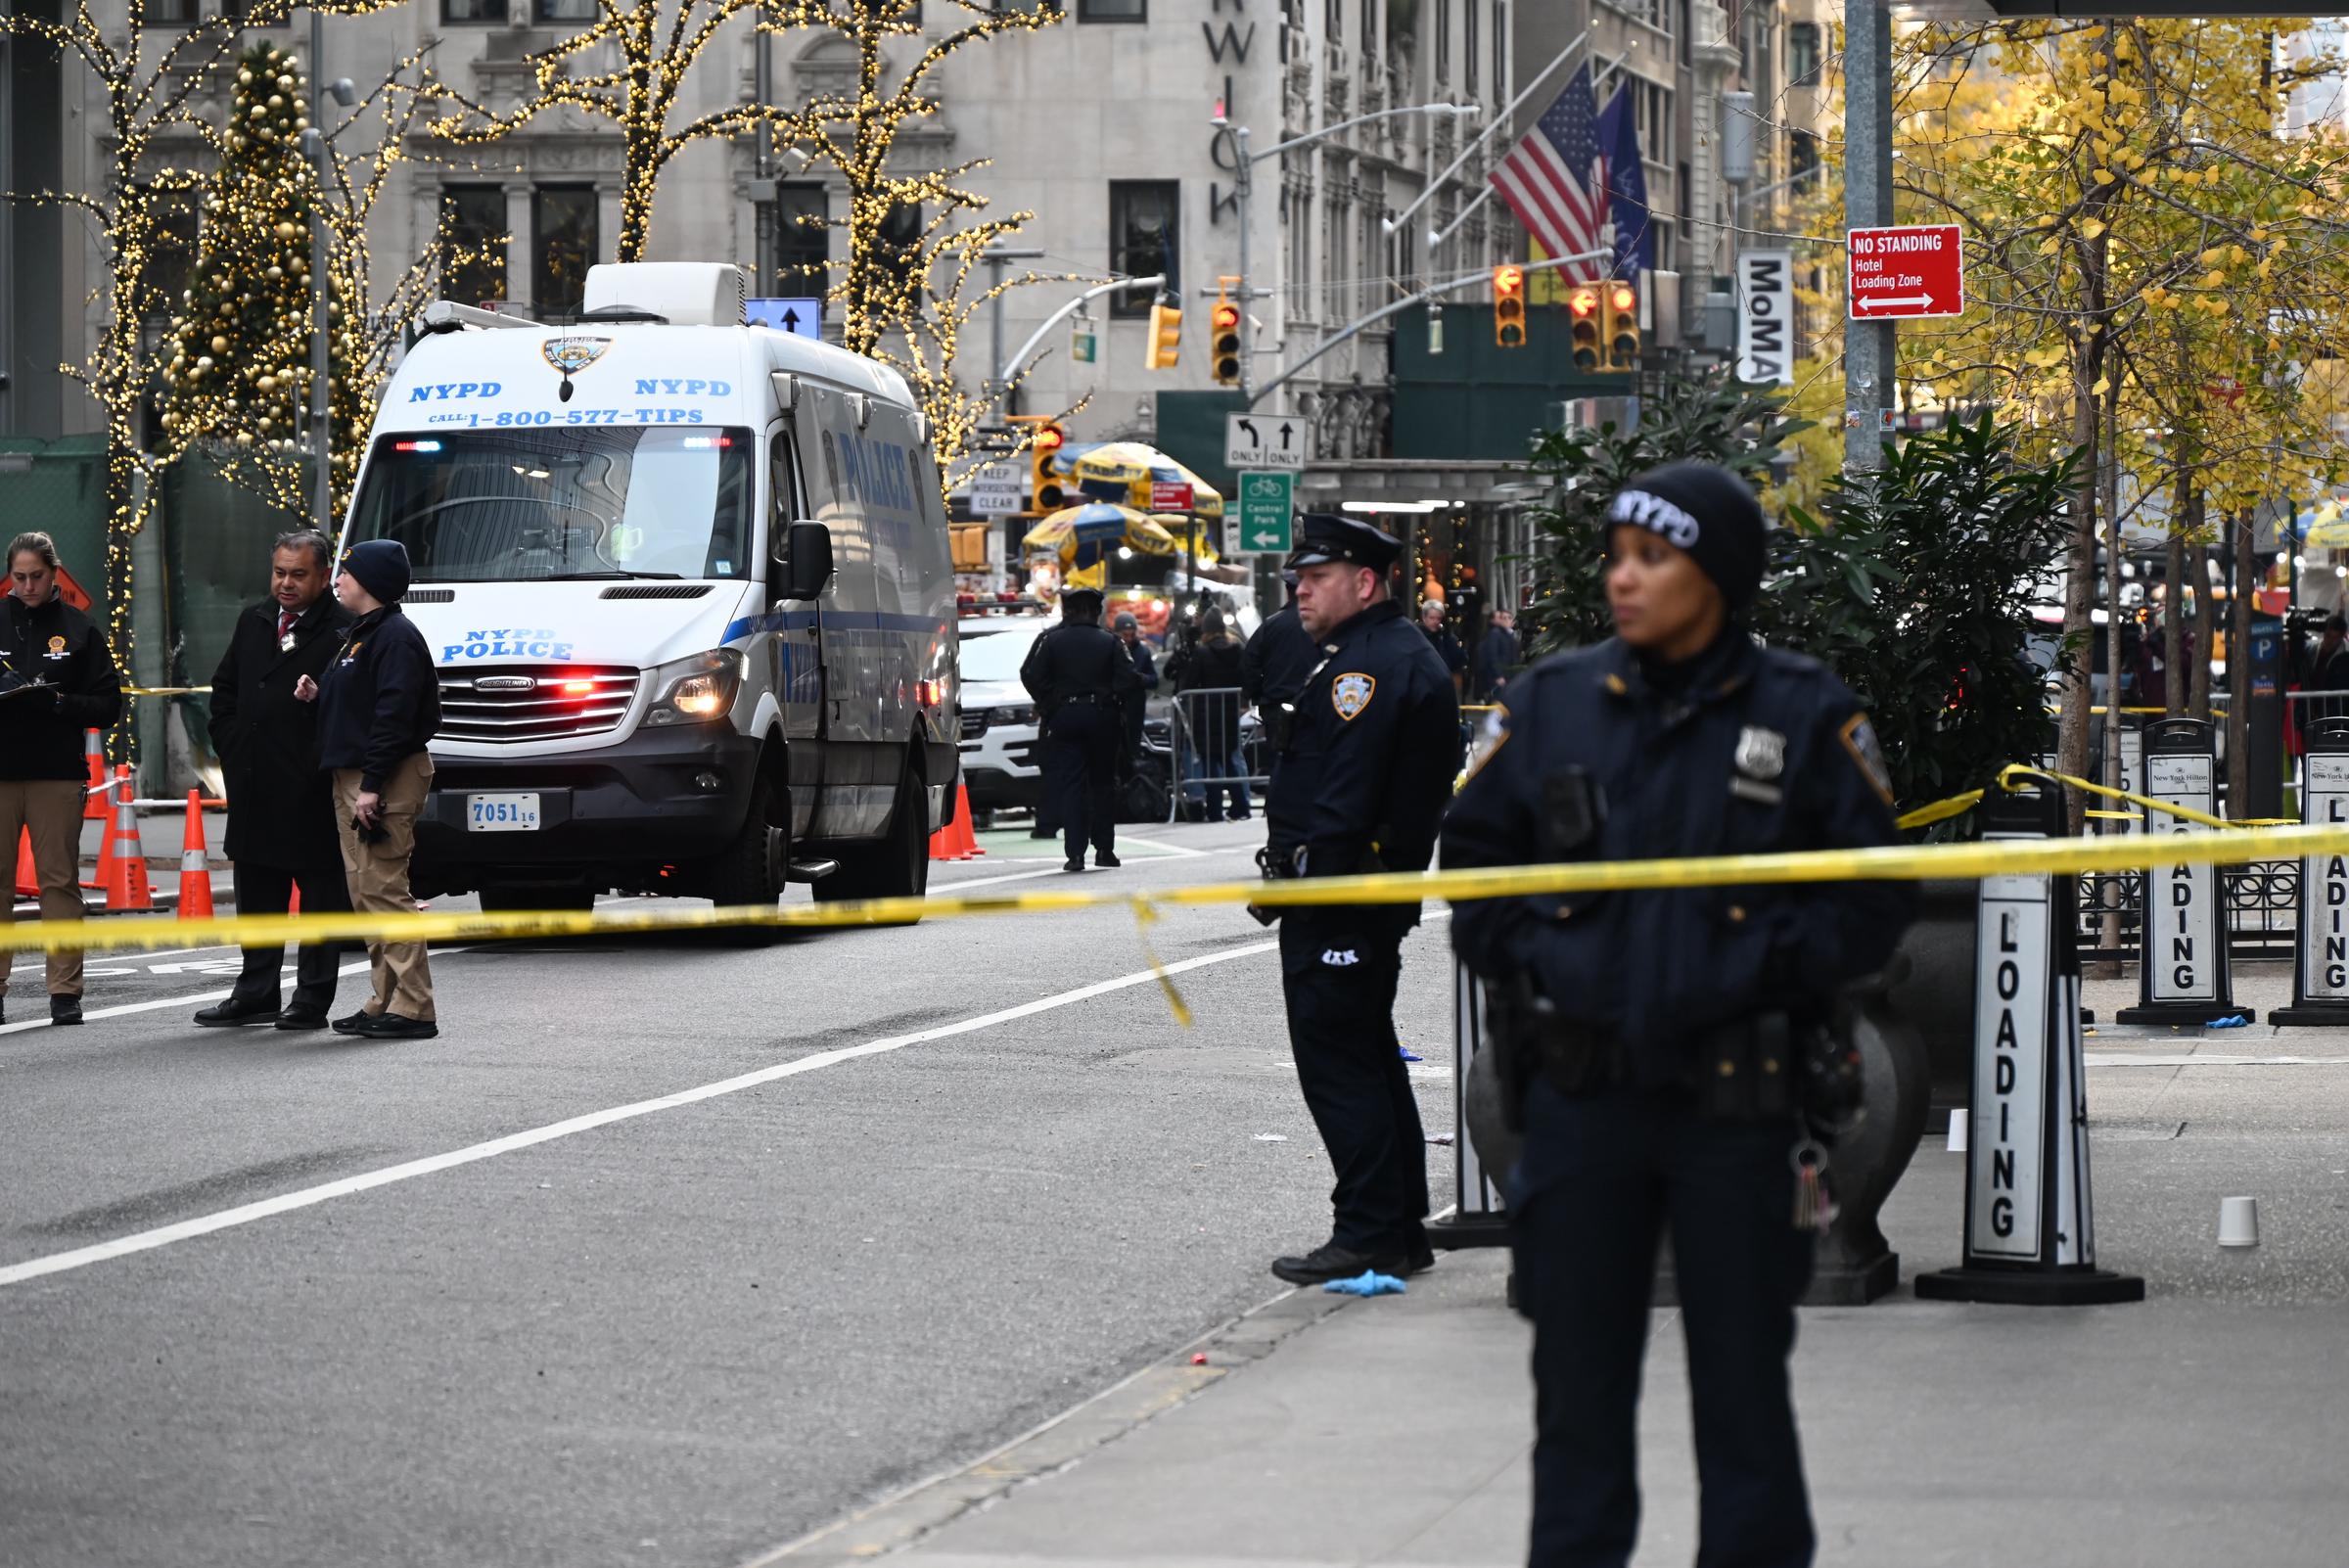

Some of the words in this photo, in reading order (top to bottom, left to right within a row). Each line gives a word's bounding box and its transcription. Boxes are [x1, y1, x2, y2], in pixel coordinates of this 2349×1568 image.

[1856, 238, 1873, 254] NO
[1877, 235, 1942, 253] STANDING
[1856, 258, 1883, 272] Hotel
[1856, 275, 1895, 290] Loading
[1898, 273, 1922, 287] Zone
[1750, 259, 1782, 380] MoMA
[408, 382, 501, 402] NYPD
[635, 379, 731, 396] NYPD
[429, 414, 468, 423] CALL:
[468, 409, 703, 427] 1-800-577-TIPS
[1231, 450, 1261, 461] ONLY
[1270, 453, 1300, 463] ONLY
[983, 469, 1010, 479] KEEP
[980, 498, 1014, 509] CLEAR
[1246, 504, 1284, 514] Central
[1611, 489, 1699, 548] NYPD
[465, 629, 555, 642] NYPD
[441, 641, 574, 664] POLICE
[2259, 639, 2272, 659] P
[474, 804, 518, 821] 7051
[522, 812, 534, 821] 16
[2171, 801, 2193, 989] LADING
[2326, 800, 2347, 989] LADING
[1991, 911, 2020, 1238] LOADING
